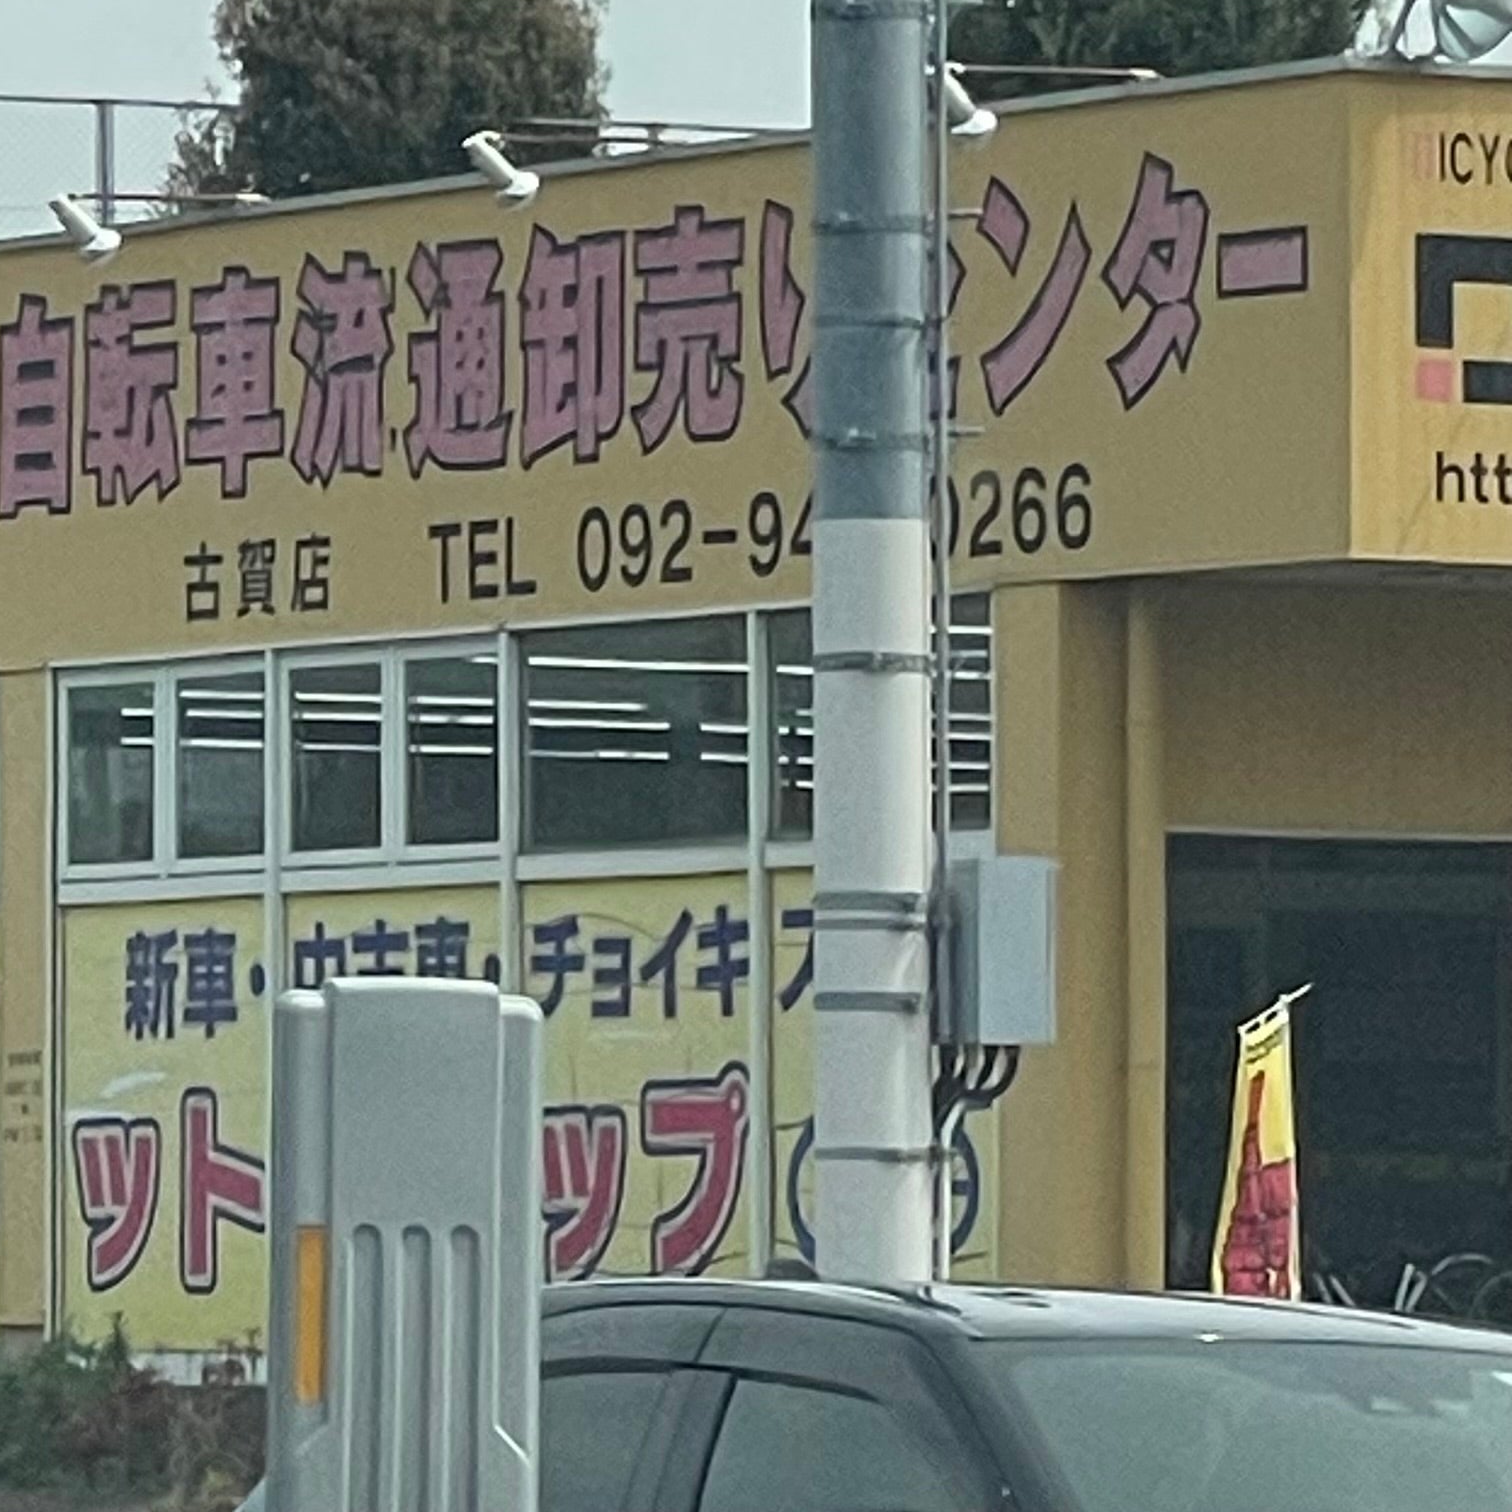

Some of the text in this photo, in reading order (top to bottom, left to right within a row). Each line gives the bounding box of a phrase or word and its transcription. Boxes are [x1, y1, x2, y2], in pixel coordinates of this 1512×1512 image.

[1437, 131, 1512, 186] ICY
[183, 533, 331, 622] 古賀店
[428, 516, 537, 604] TEL
